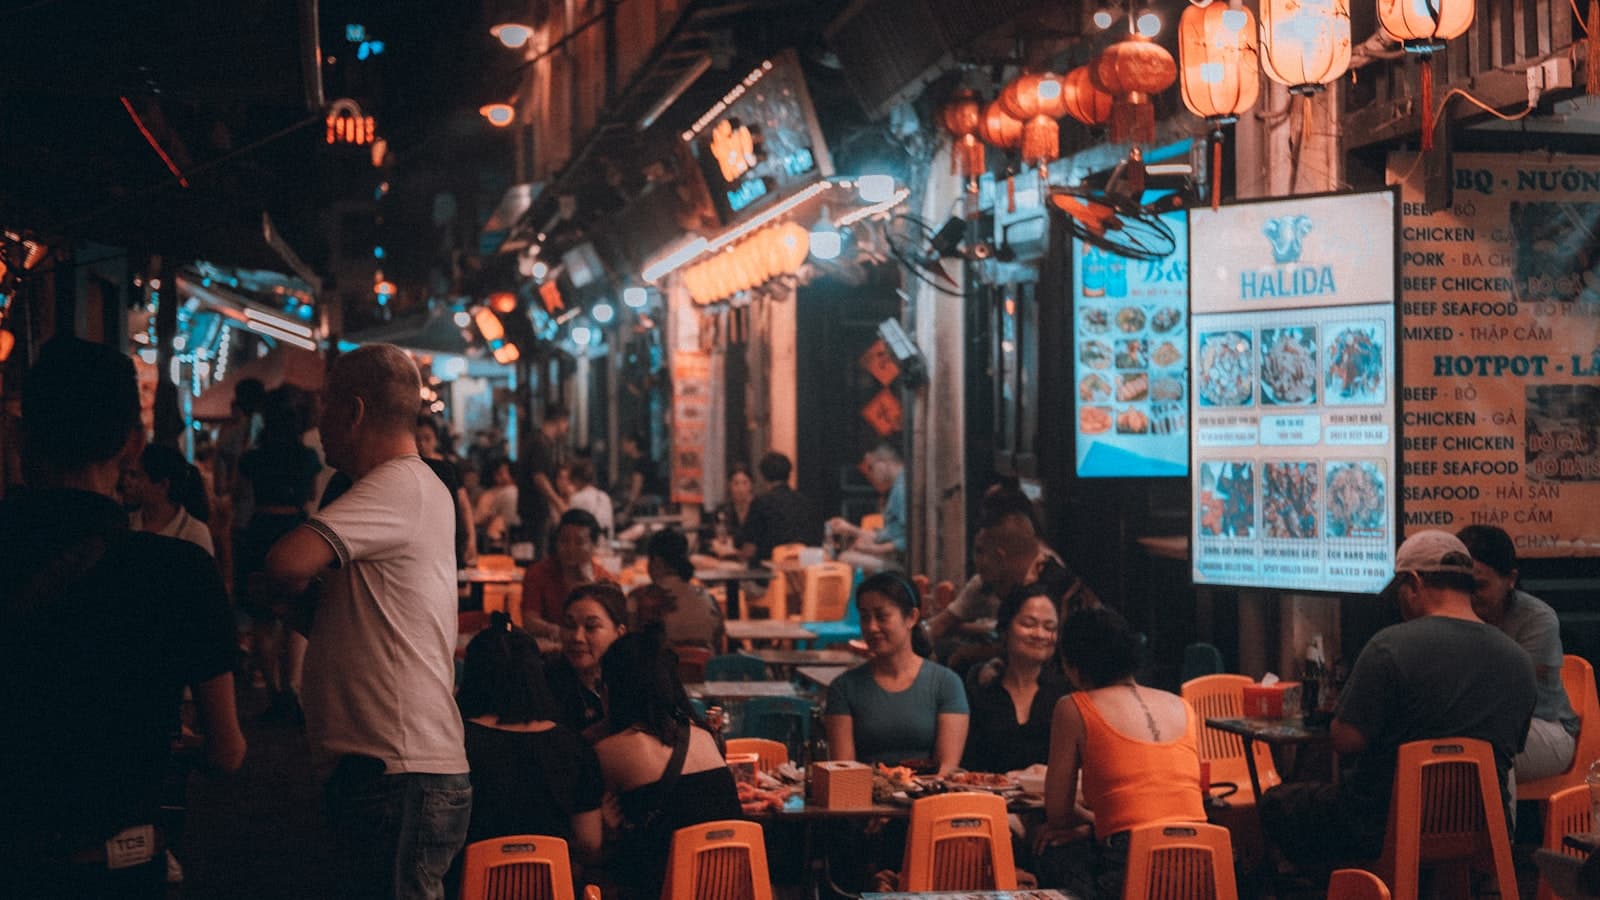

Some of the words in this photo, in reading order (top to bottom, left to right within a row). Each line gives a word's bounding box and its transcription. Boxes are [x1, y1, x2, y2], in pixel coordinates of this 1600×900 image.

[1455, 168, 1494, 195] BQ
[1403, 202, 1433, 216] BEE
[1403, 227, 1475, 241] CHICKEN
[1403, 252, 1445, 267] PORK
[1240, 264, 1337, 300] HALIDA
[1403, 277, 1437, 291] BEEF
[1441, 276, 1513, 292] CHICKEN
[1403, 302, 1437, 316] BEEF
[1441, 302, 1518, 317] SEAFOOD
[1403, 326, 1453, 341] MIXED
[1433, 355, 1548, 377] HOTPOT
[1404, 387, 1438, 401] BEEF
[1404, 411, 1476, 426] CHICKEN
[1404, 436, 1437, 451] BEEF
[1442, 436, 1514, 451] CHICKEN
[1404, 461, 1437, 475] BEEF
[1442, 461, 1519, 475] SEAFOOD
[1404, 485, 1480, 500] SEAFOOD
[1404, 511, 1454, 525] MIXED
[1515, 534, 1560, 549] CHAY
